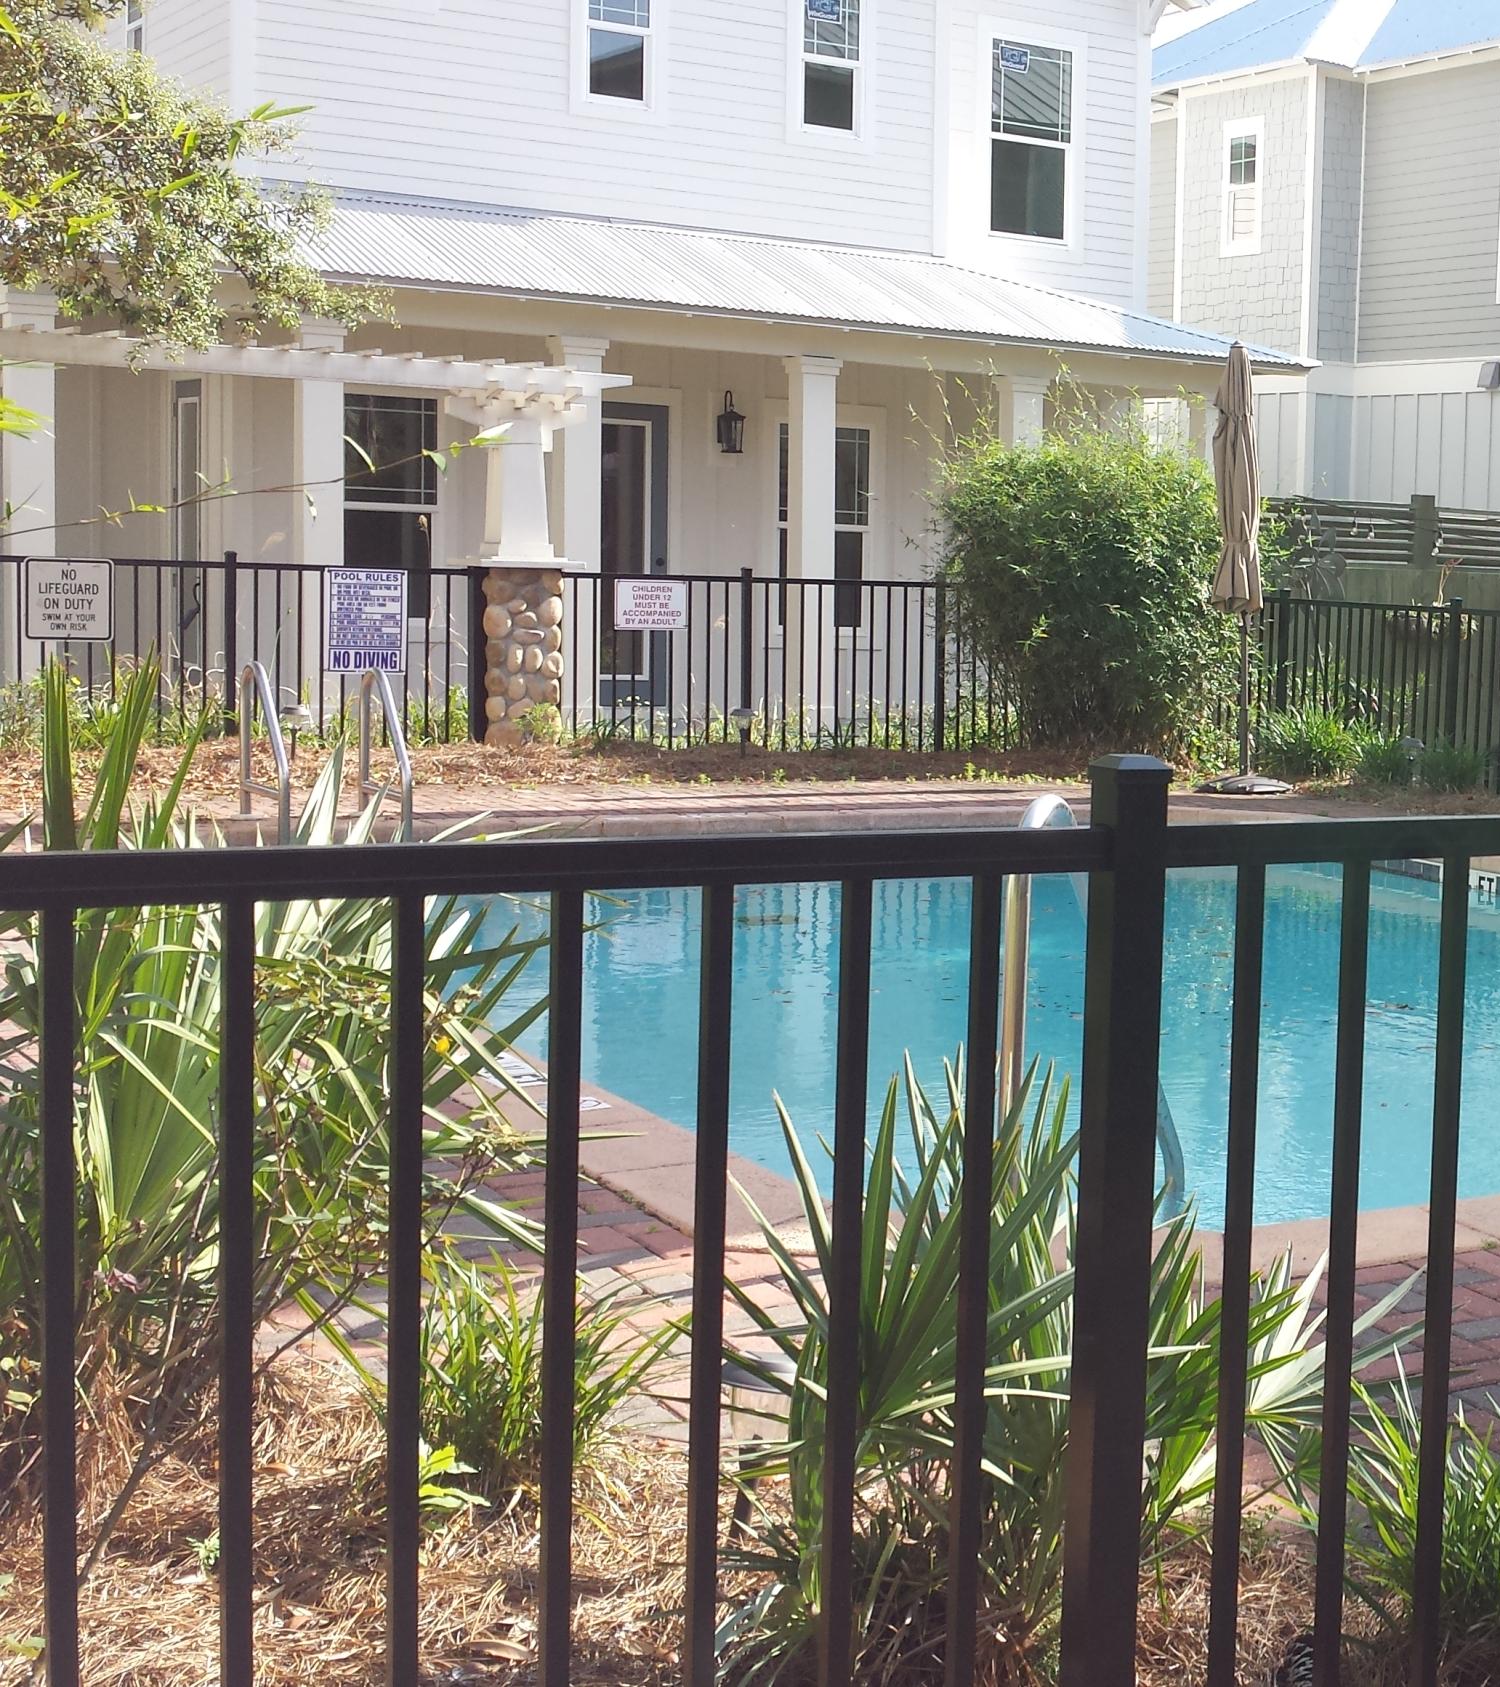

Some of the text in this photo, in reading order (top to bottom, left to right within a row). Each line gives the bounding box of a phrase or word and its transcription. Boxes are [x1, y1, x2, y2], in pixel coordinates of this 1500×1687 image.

[61, 569, 77, 580] NO
[334, 572, 399, 582] POOL RULES
[38, 582, 99, 595] LIFEGUARD
[43, 598, 93, 610] ON DUTY
[42, 613, 61, 621] SWIM
[50, 622, 87, 631] OWN RISK
[333, 650, 397, 669] NO DIVING
